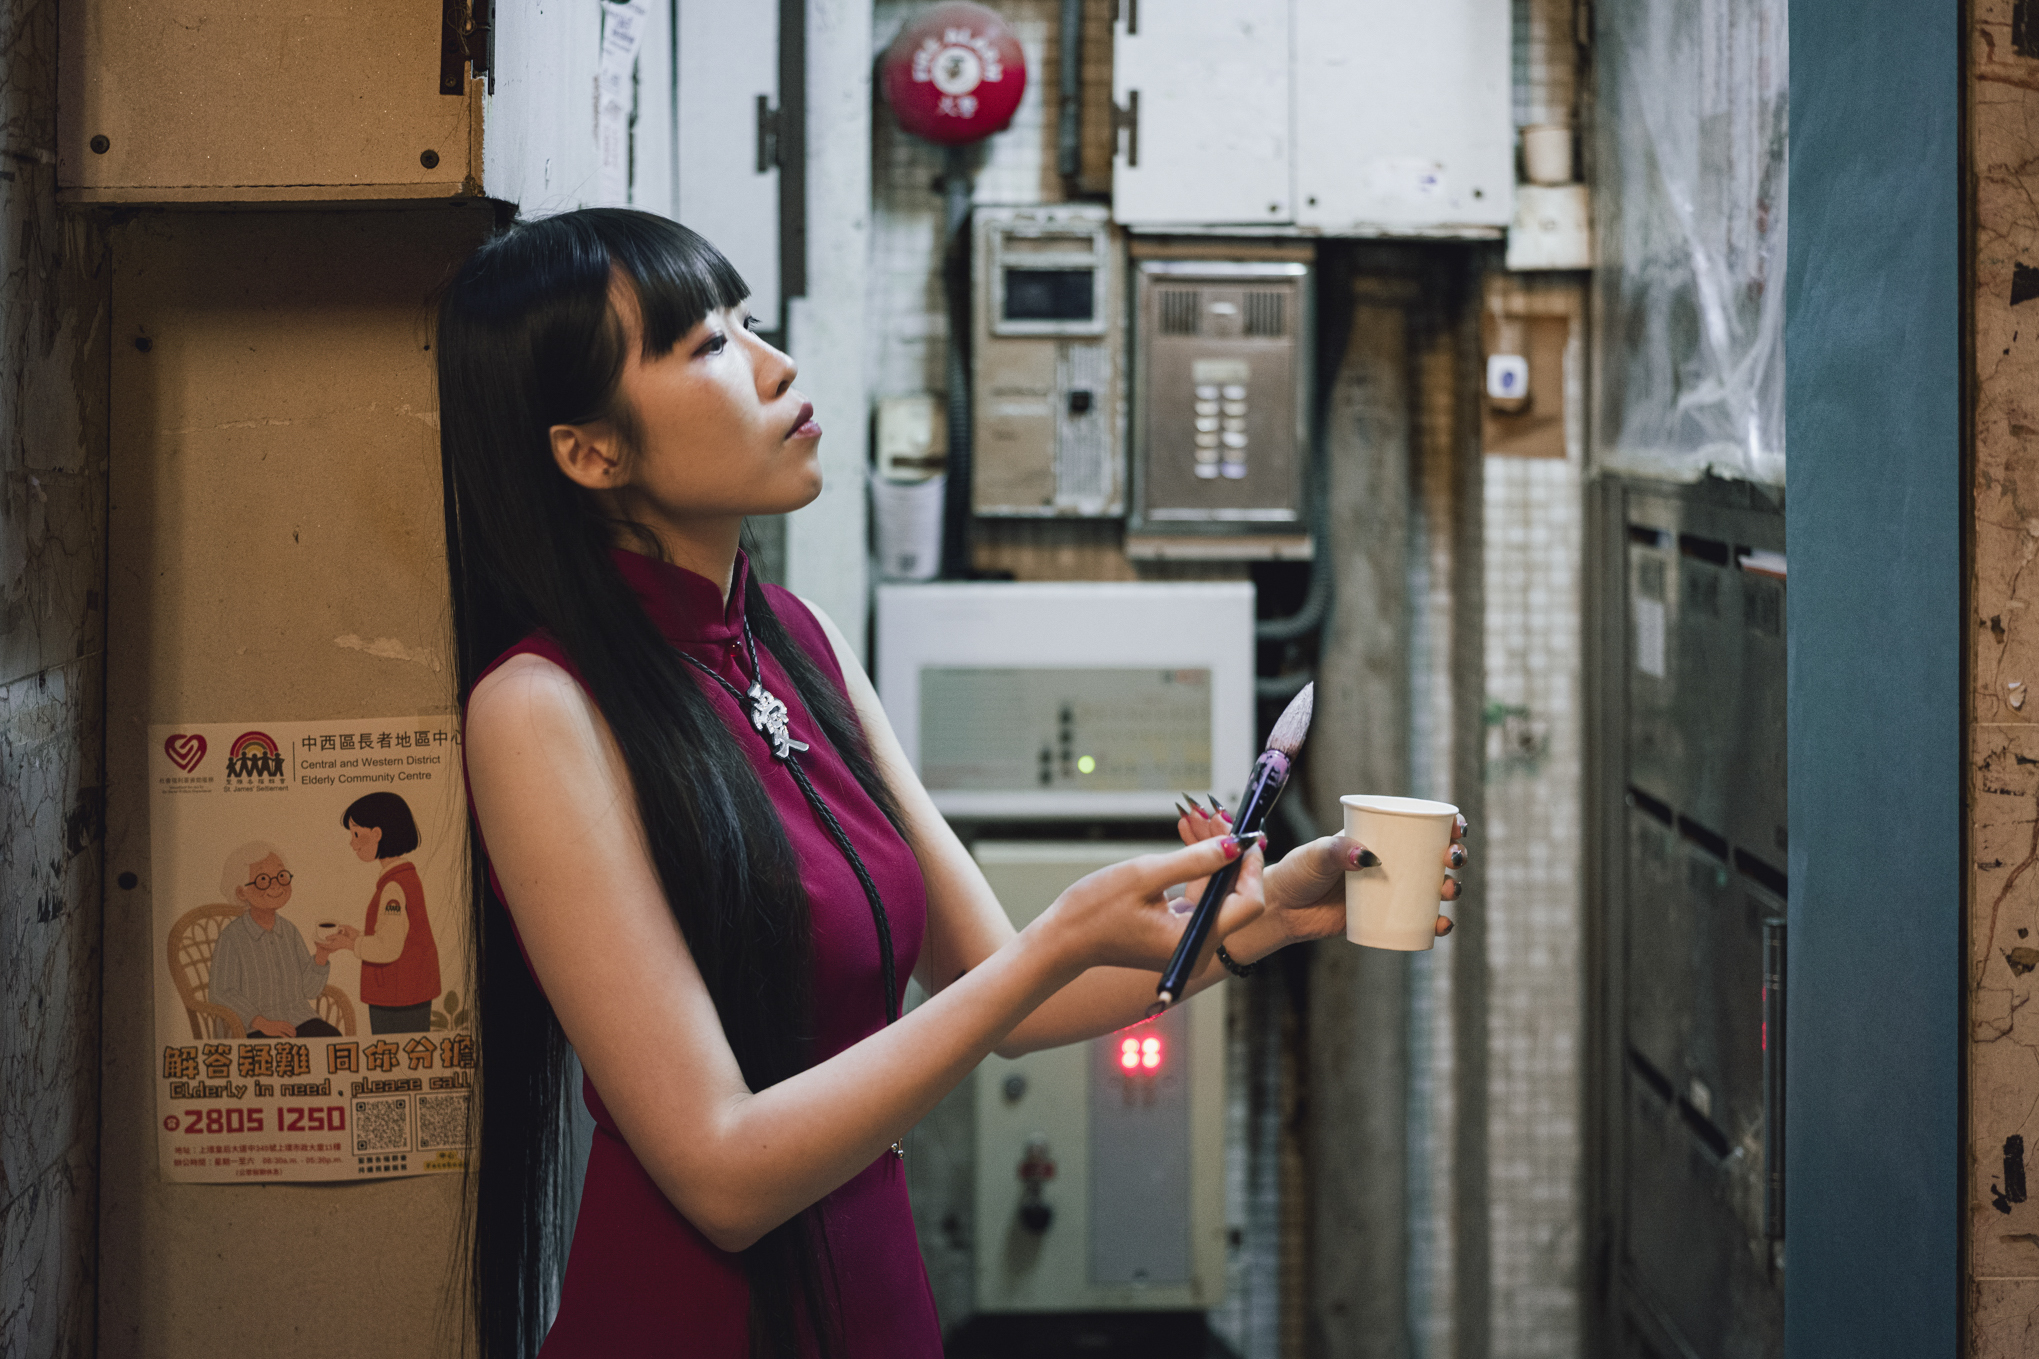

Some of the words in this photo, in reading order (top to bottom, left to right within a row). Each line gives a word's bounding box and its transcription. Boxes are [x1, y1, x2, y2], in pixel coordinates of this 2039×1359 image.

[301, 759, 337, 769] Central
[340, 758, 358, 768] and
[362, 757, 403, 767] Western
[407, 755, 441, 765] District
[256, 784, 289, 792] Settlement
[302, 775, 336, 786] Elderly
[339, 773, 396, 783] Community
[398, 771, 432, 781] Centre
[163, 1042, 311, 1079] 解答疑難
[326, 1033, 475, 1075] 同你分擔
[169, 1080, 248, 1100] Elderly
[254, 1080, 274, 1097] in
[350, 1075, 423, 1097] please
[429, 1070, 471, 1090] call
[184, 1108, 264, 1134] 2805
[277, 1106, 346, 1132] 1250
